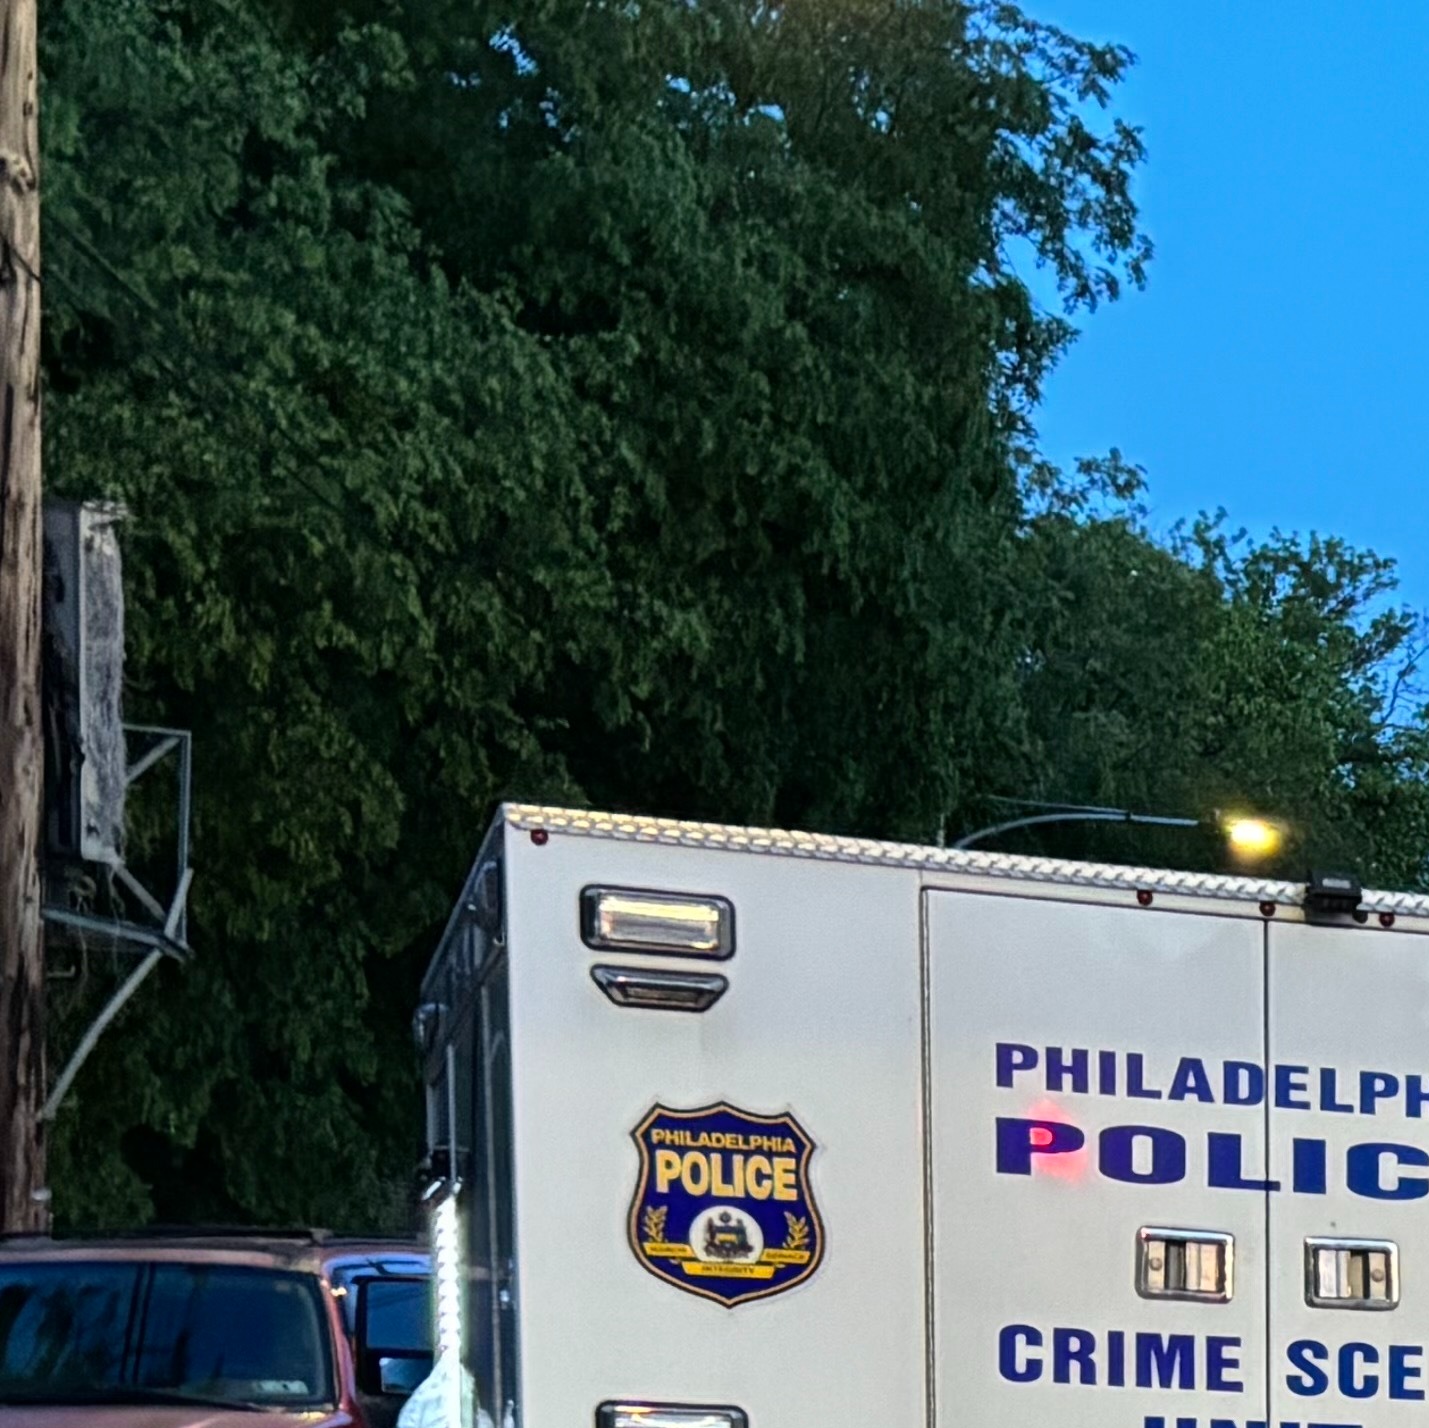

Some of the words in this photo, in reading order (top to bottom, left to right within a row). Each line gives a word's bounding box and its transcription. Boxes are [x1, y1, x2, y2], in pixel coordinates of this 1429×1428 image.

[651, 1127, 797, 1154] PHILADELPHIA
[655, 1148, 799, 1202] POLICE
[998, 1324, 1245, 1394] CRIME
